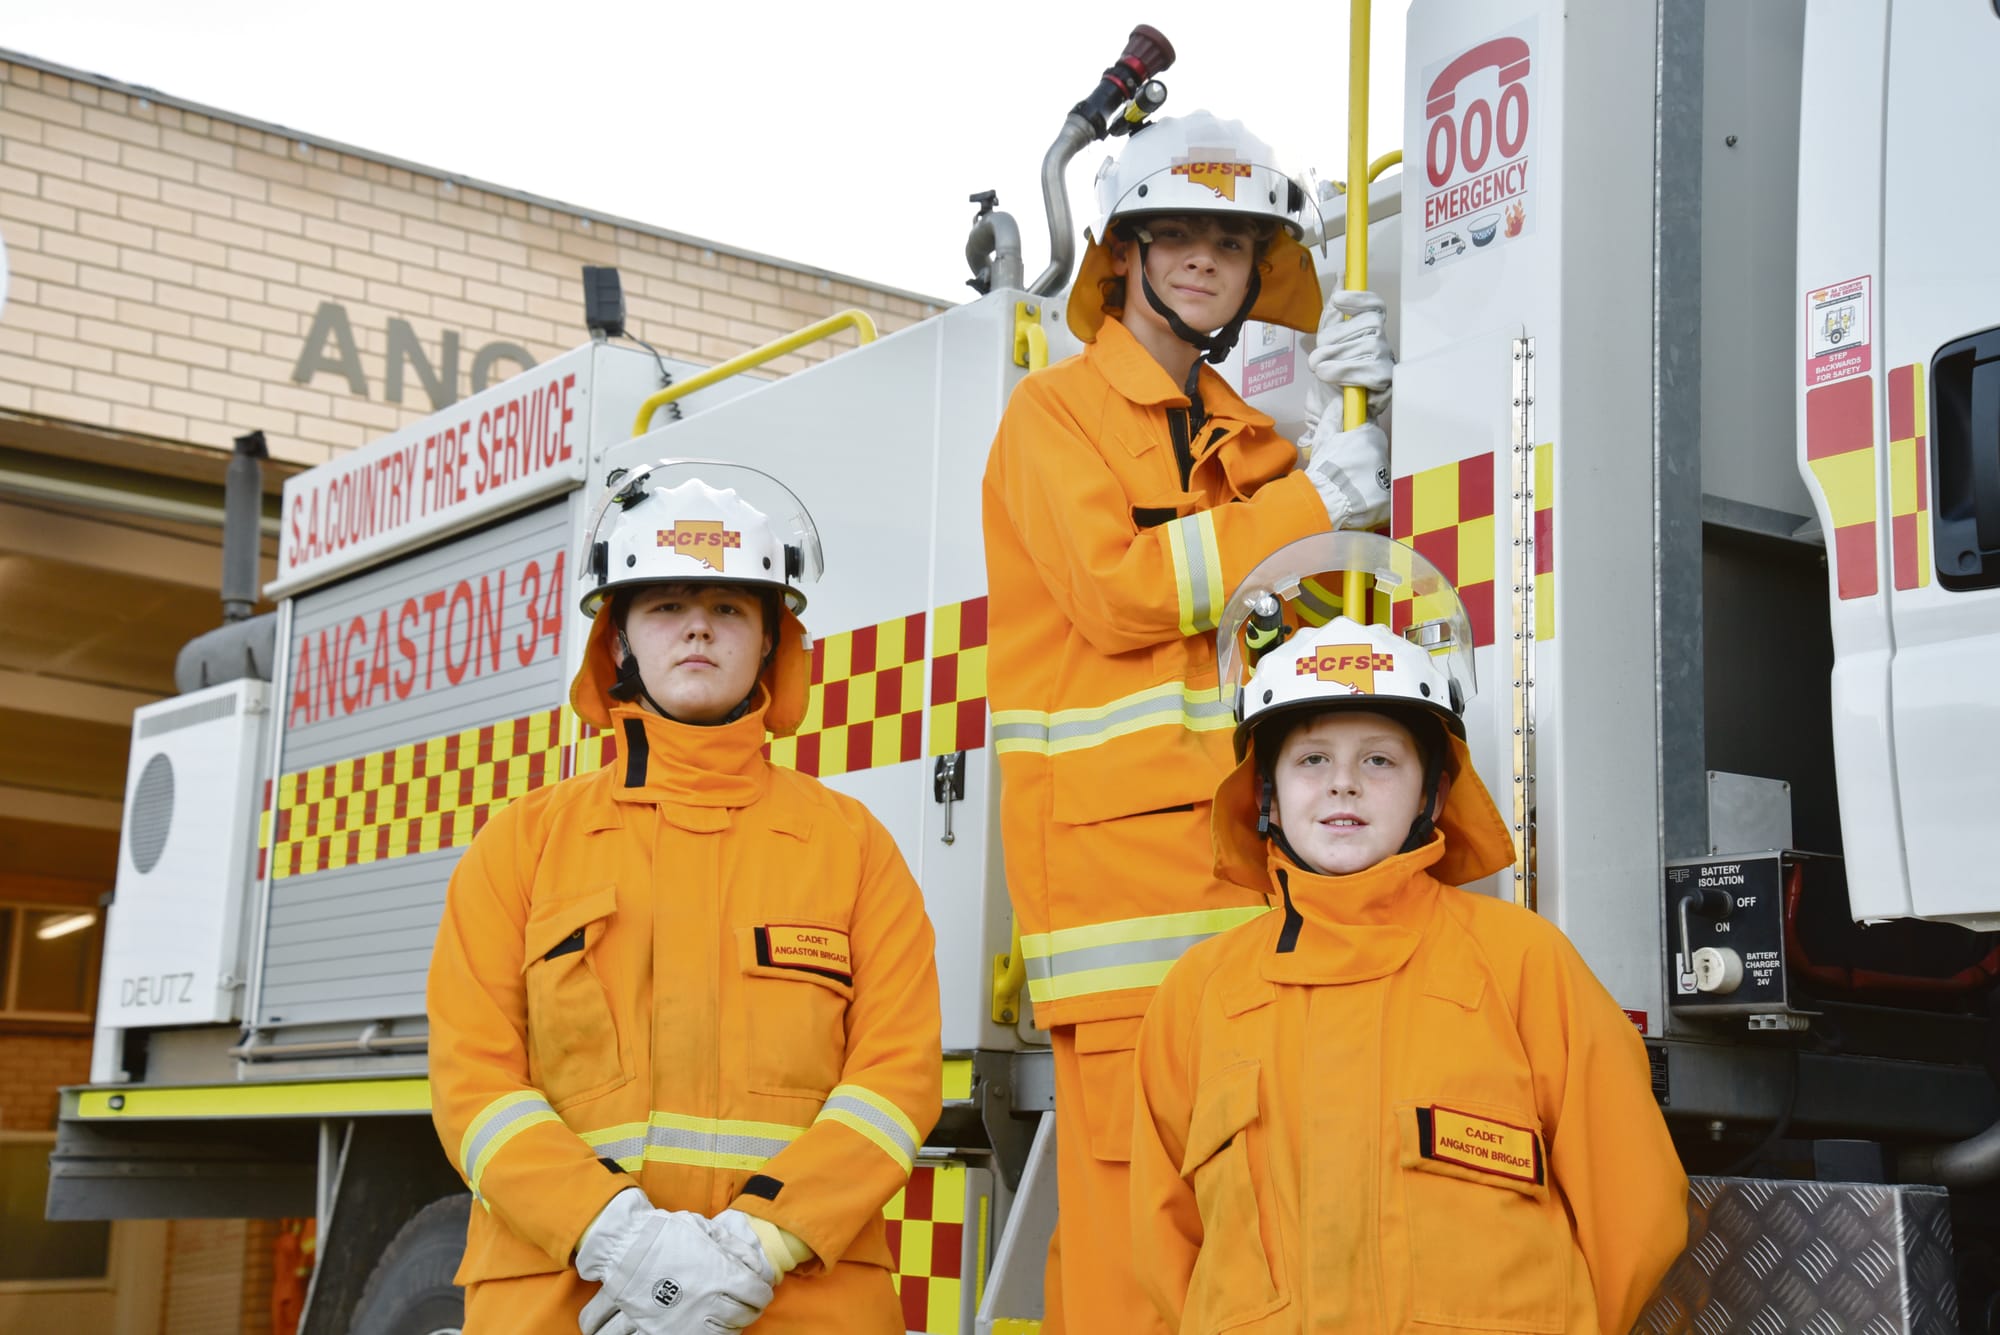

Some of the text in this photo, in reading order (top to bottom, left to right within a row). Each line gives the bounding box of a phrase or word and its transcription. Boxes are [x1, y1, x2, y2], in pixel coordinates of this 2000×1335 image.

[1426, 82, 1529, 188] 000
[1190, 162, 1233, 175] CFS
[1425, 159, 1528, 229] EMERGENCY
[1829, 351, 1848, 362] STEP
[1260, 358, 1277, 371] STEP
[1815, 356, 1862, 374] BACKWARDS
[1248, 364, 1288, 385] BACKWARDS
[1816, 365, 1861, 382] FOR SAFETY
[1249, 375, 1288, 394] FOR SAFETY
[421, 420, 471, 518] FIRE
[475, 372, 576, 495] SERVICE
[677, 532, 721, 546] CFS
[289, 550, 565, 728] ANGASTON 34
[1319, 655, 1370, 672] CFS
[1701, 864, 1741, 876] BATTERY
[1698, 875, 1744, 888] ISOLATION
[1736, 897, 1757, 908] OFF
[1715, 922, 1730, 932] ON
[796, 934, 829, 946] CADET
[774, 946, 848, 965] ANGASTON BRIGADE
[1746, 951, 1778, 961] BATTERY
[1745, 960, 1780, 969] CHARGER
[1753, 969, 1773, 977] INLET
[1757, 978, 1770, 986] 24V
[120, 972, 195, 1008] DEUTZ
[1465, 1127, 1504, 1145] CADET
[1440, 1136, 1531, 1168] ANGASTON BRIGADE
